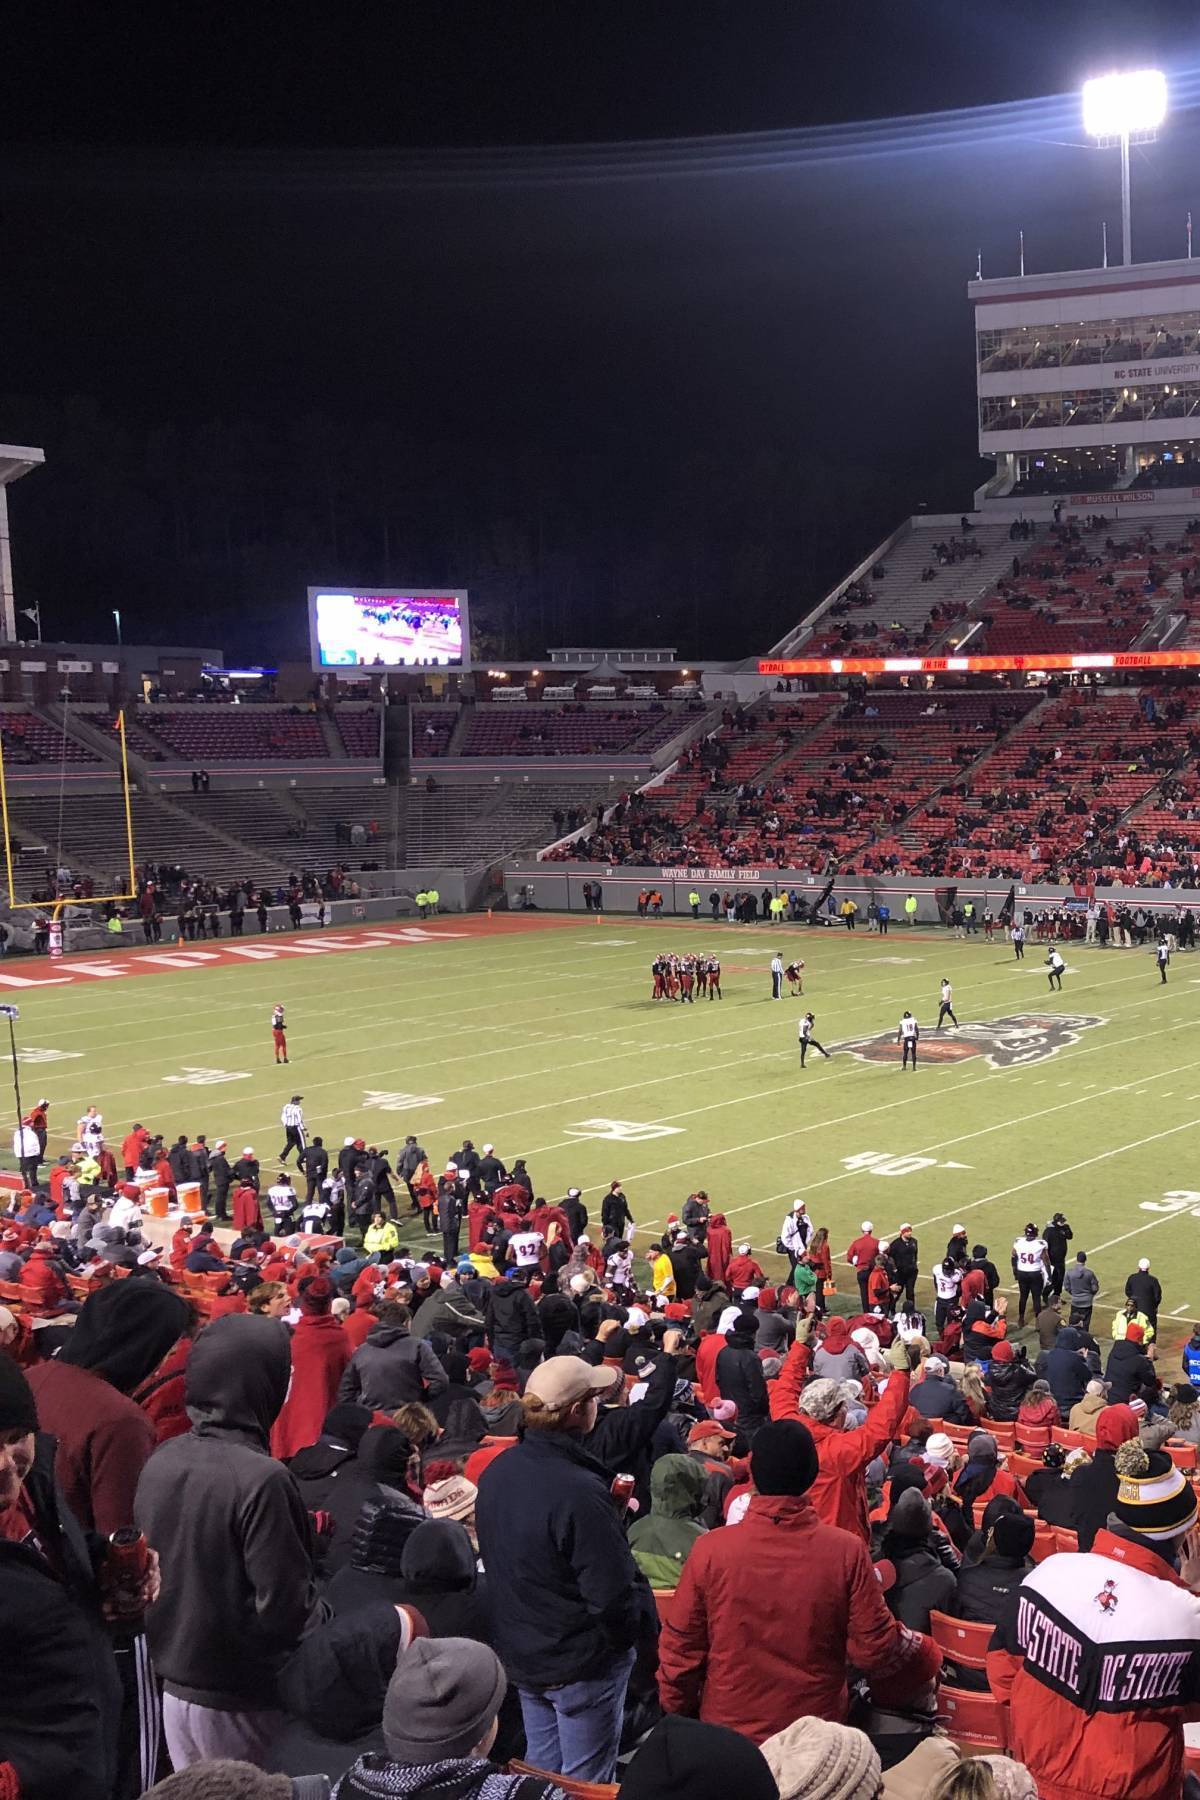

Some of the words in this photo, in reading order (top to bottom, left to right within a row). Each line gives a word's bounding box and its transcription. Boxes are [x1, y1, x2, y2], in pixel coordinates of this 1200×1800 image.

[1114, 369, 1126, 379] NC
[1128, 367, 1152, 378] STATE
[1154, 363, 1200, 376] UNIVERSITY
[1086, 495, 1120, 504] RUSSELL
[1122, 492, 1153, 502] WILSON
[923, 661, 932, 671] IN
[933, 660, 947, 670] THE
[1115, 656, 1152, 666] FOOTBALL
[661, 868, 688, 880] WAYNE
[691, 868, 706, 880] DAY
[708, 869, 737, 880] FAMILY
[739, 870, 761, 880] FIELD
[562, 1118, 688, 1142] 50
[839, 1150, 938, 1176] 40
[518, 1243, 537, 1256] 92
[1020, 1252, 1036, 1265] 50
[1017, 1596, 1036, 1649] NC
[1026, 1609, 1082, 1695] STATE
[1098, 1653, 1128, 1702] NC
[1119, 1650, 1192, 1701] STATE
